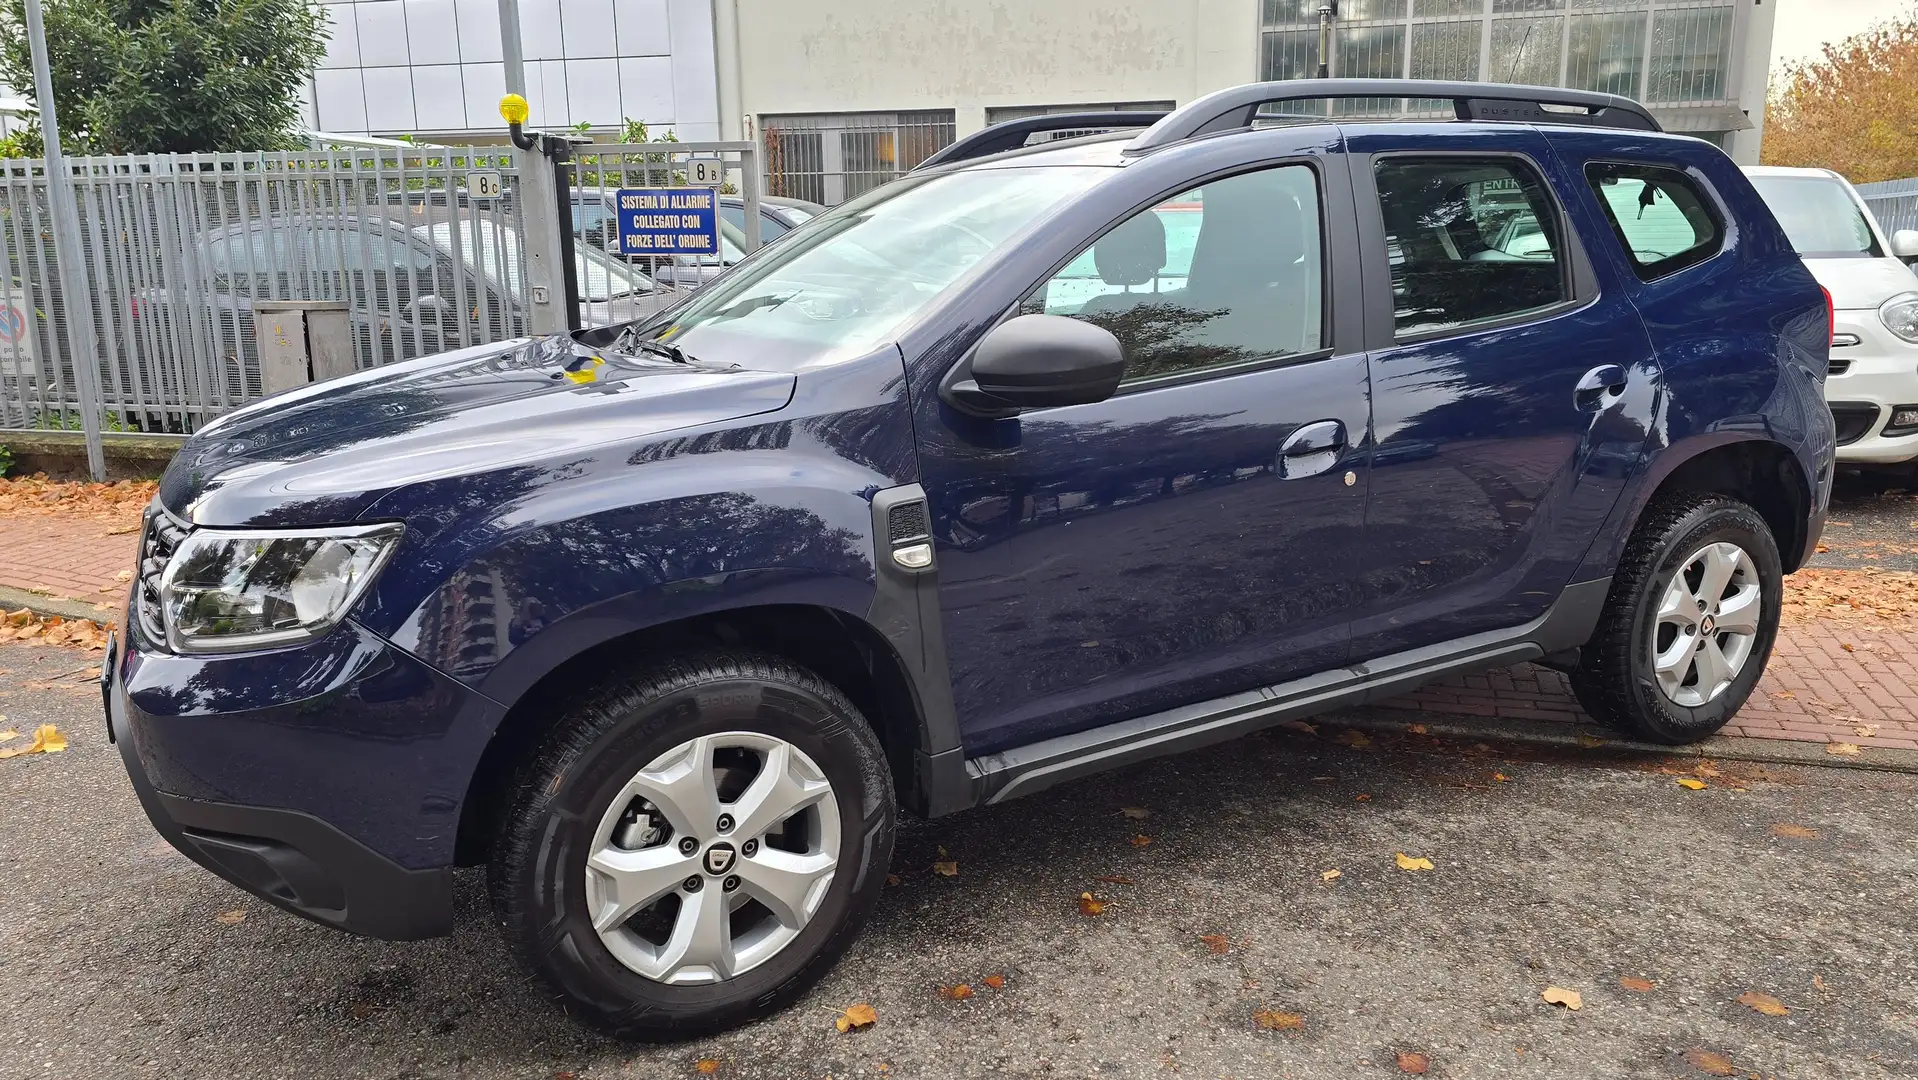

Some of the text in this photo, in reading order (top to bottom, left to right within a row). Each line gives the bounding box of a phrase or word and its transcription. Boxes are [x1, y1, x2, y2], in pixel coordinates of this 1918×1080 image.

[1481, 107, 1540, 117] DUSTER
[697, 163, 717, 181] 8 B
[480, 176, 488, 194] 8
[621, 194, 711, 209] SISTEMA DI ALLARME
[633, 214, 700, 228] COLLEGATO CON
[626, 234, 710, 248] FORZE DELL' ORDINE
